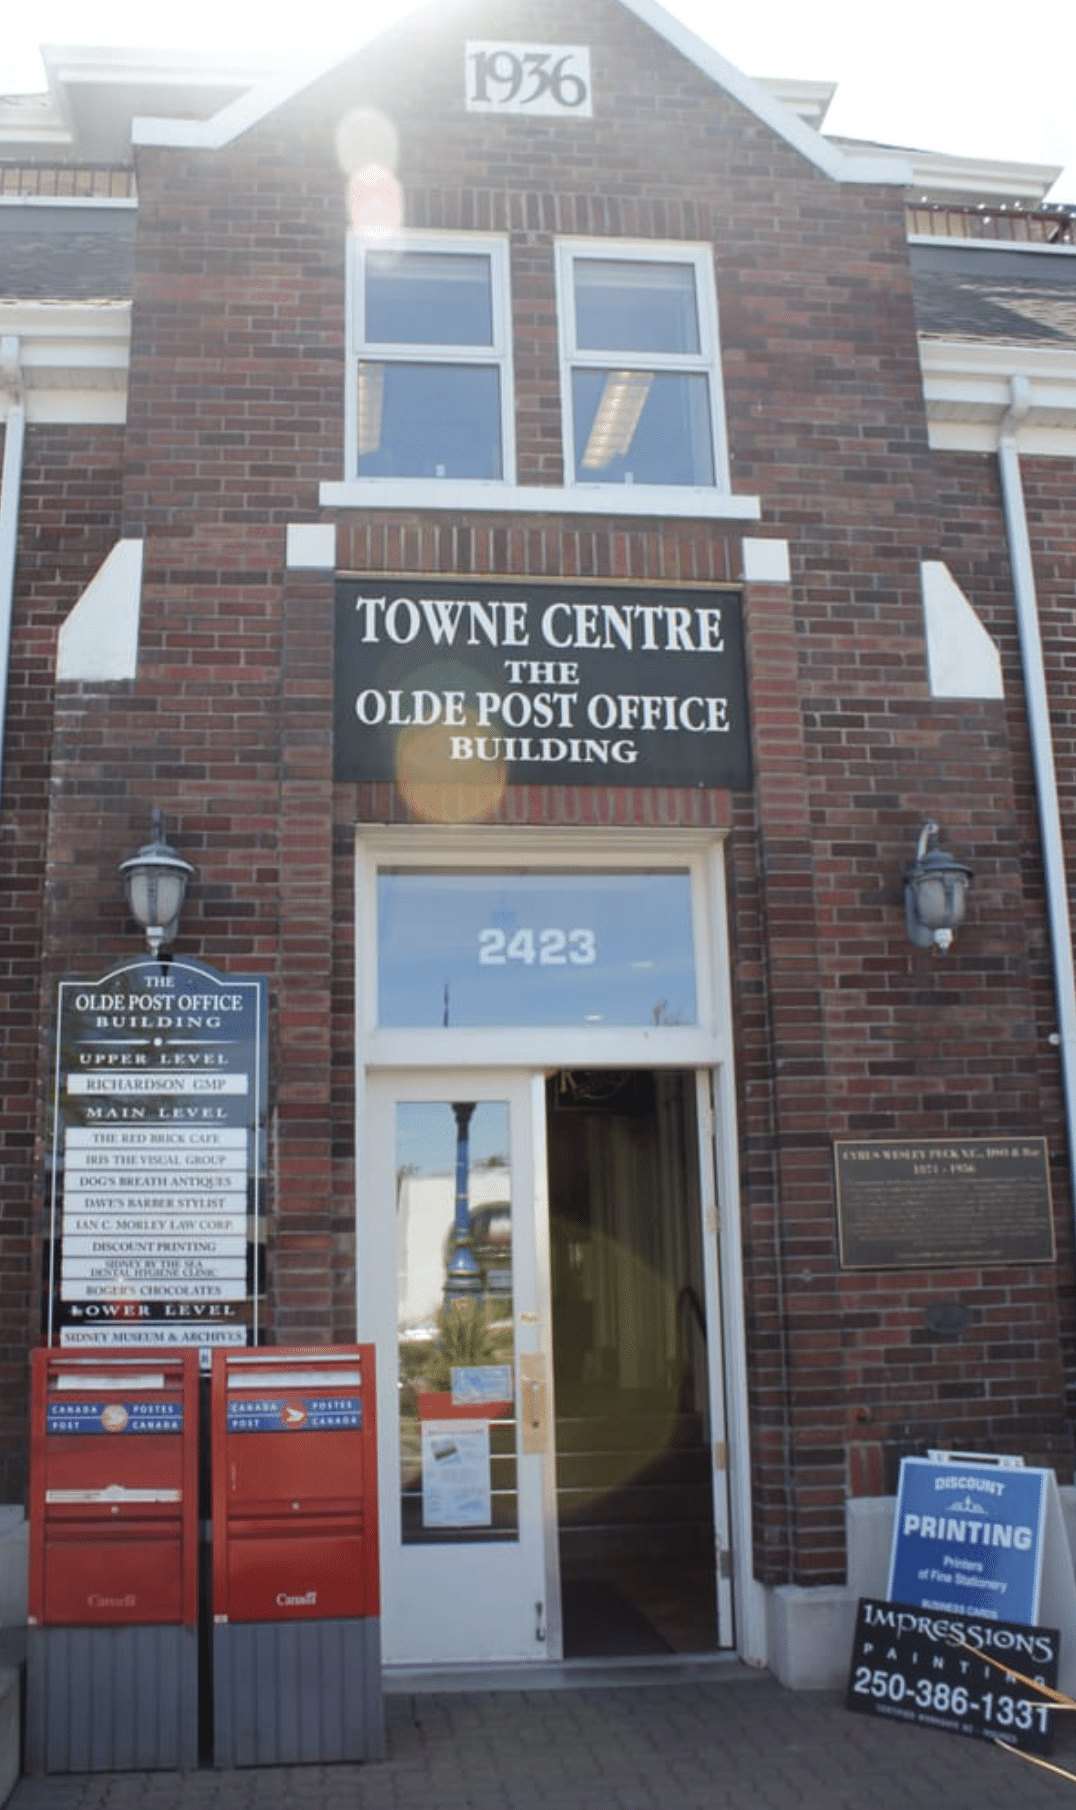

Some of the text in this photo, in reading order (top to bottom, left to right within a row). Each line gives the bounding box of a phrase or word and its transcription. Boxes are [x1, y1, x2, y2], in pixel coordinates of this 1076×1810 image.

[468, 50, 587, 107] 1936
[356, 597, 725, 652] TOWNE CENTRE
[505, 660, 580, 685] THE
[356, 689, 730, 732] OLDE POST OFFICE
[450, 736, 639, 764] BUILDING
[478, 929, 597, 965] 2423
[144, 976, 175, 988] THE
[75, 994, 243, 1012] OLDE POST OFFICE
[96, 1016, 222, 1028] BUILDING
[79, 1053, 229, 1065] UPPER LEVEL
[86, 1079, 185, 1091] RICHARDSON
[86, 1107, 228, 1119] MAIN LEVEL
[93, 1133, 116, 1144] THE
[121, 1133, 147, 1144] RED
[150, 1133, 185, 1144] BRICK
[86, 1154, 227, 1165] IRIS THE VISUAL GROUP
[80, 1176, 232, 1189] DOG'S BREATH ANTIQUES
[127, 1197, 175, 1208] BARBER
[177, 1197, 226, 1208] STYLIST
[115, 1219, 165, 1230] MORLEY
[169, 1219, 197, 1230] LAW
[92, 1241, 217, 1252] DISCOUNT PRINTING
[161, 1260, 181, 1268] THE
[140, 1285, 222, 1296] CHOCOLATES
[71, 1305, 236, 1316] LOWER LEVEL
[65, 1331, 244, 1342] SIDNEY MUSEUM & ARCHIVES
[51, 1404, 98, 1414] CANADA
[132, 1404, 175, 1414] POSTES
[230, 1402, 279, 1413] CANADA
[311, 1400, 353, 1410] POSTES
[52, 1421, 81, 1430] POST
[132, 1420, 179, 1430] CANADA
[231, 1418, 261, 1429] POST
[311, 1416, 357, 1426] CANADA
[934, 1476, 1006, 1496] DISCOUNT
[903, 1514, 1033, 1551] PRINTING
[943, 1555, 984, 1573] Printers
[918, 1570, 929, 1581] of
[930, 1571, 953, 1584] Fine
[862, 1604, 1054, 1663] IMPRESSIONS
[854, 1665, 1050, 1734] 250-386-1331
